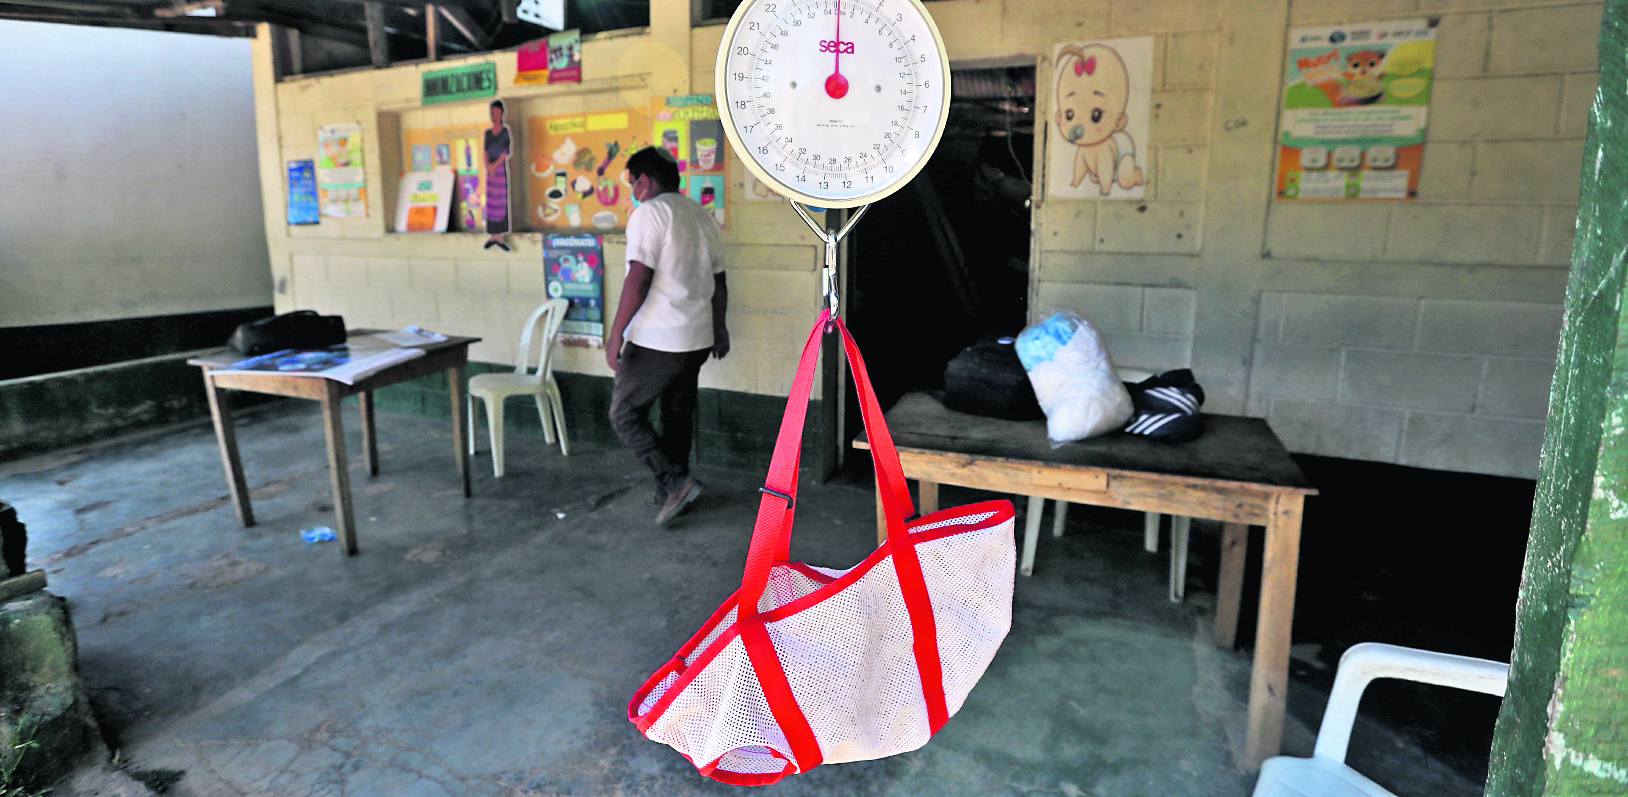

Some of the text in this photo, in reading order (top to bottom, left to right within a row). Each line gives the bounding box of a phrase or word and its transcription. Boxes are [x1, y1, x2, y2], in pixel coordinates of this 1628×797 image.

[765, 3, 777, 12] 22
[896, 13, 902, 22] 3
[749, 21, 760, 30] 21
[911, 34, 916, 42] 4
[736, 46, 748, 56] 20
[819, 40, 854, 54] seca
[920, 54, 926, 62] 5
[733, 72, 744, 81] 19
[735, 100, 746, 109] 18
[744, 125, 754, 133] 17
[758, 146, 768, 154] 16
